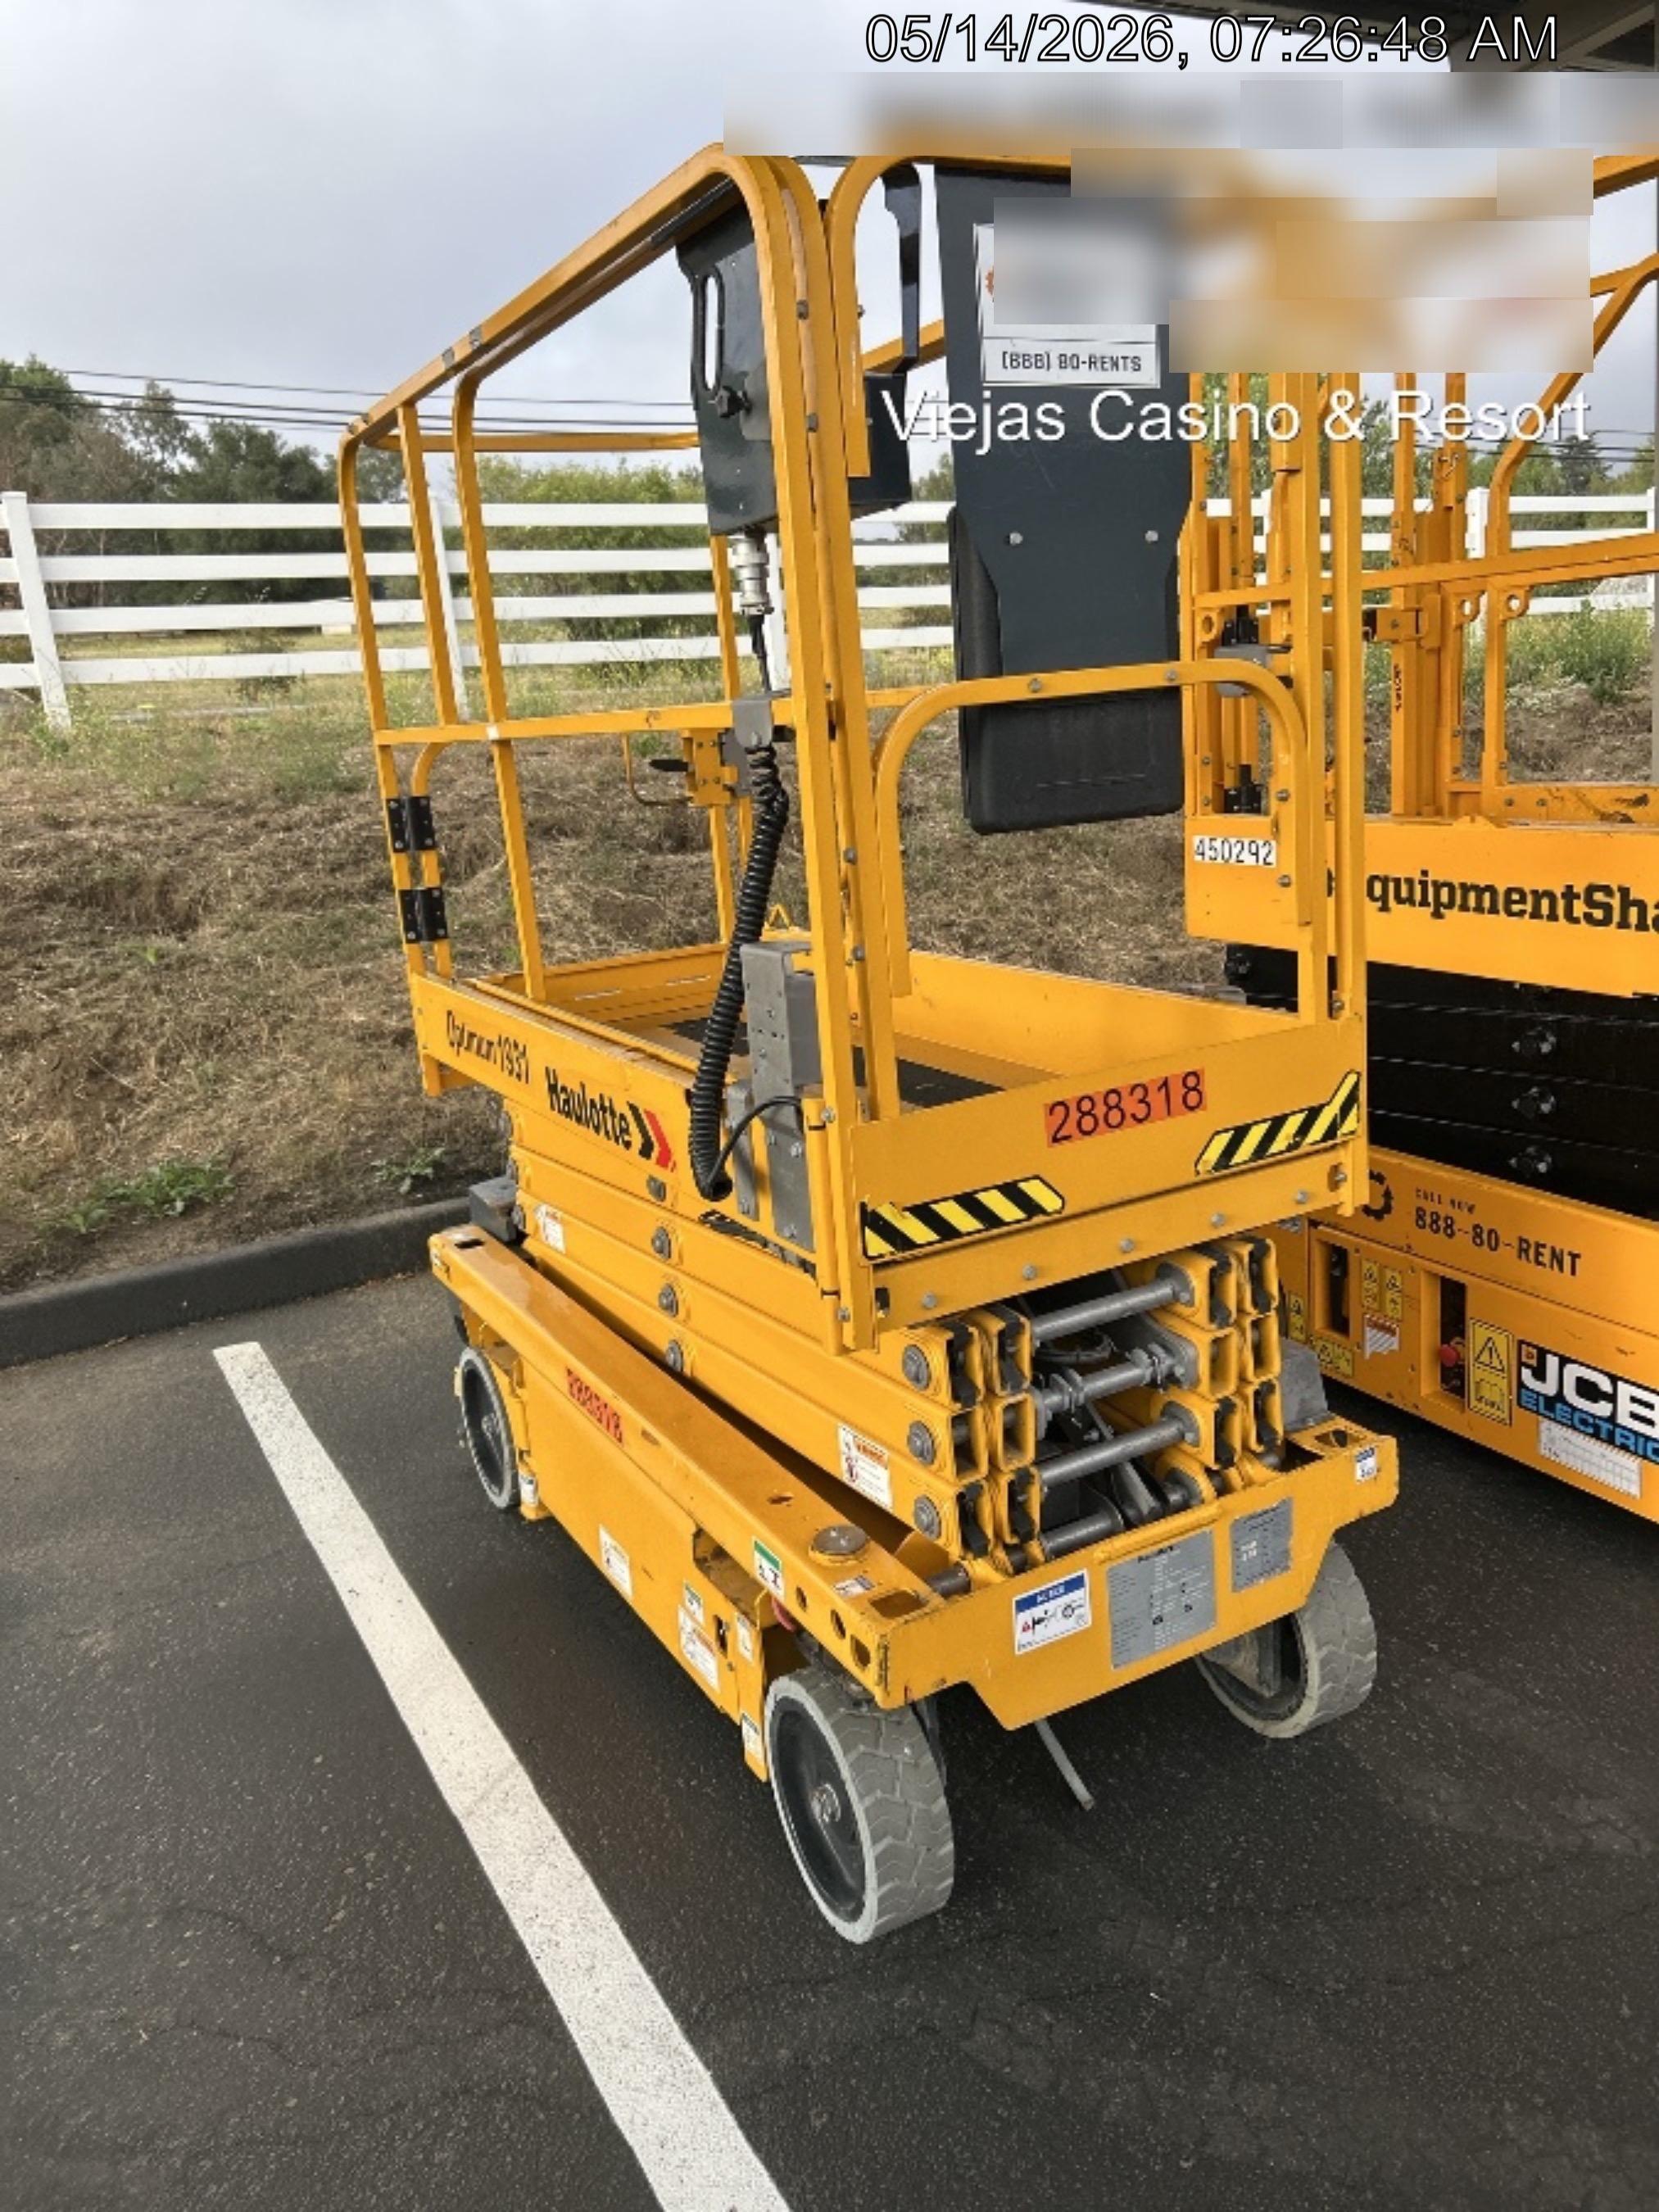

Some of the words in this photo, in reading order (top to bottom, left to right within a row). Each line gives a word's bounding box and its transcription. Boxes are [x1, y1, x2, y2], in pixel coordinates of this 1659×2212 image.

[1058, 353, 1142, 372] 80-RENTS
[1194, 837, 1275, 866] 450292
[545, 1066, 632, 1150] Haulotte
[1049, 1071, 1203, 1144] 288318
[1415, 1206, 1582, 1277] 888-80-RENT
[1521, 1352, 1659, 1440] JCB
